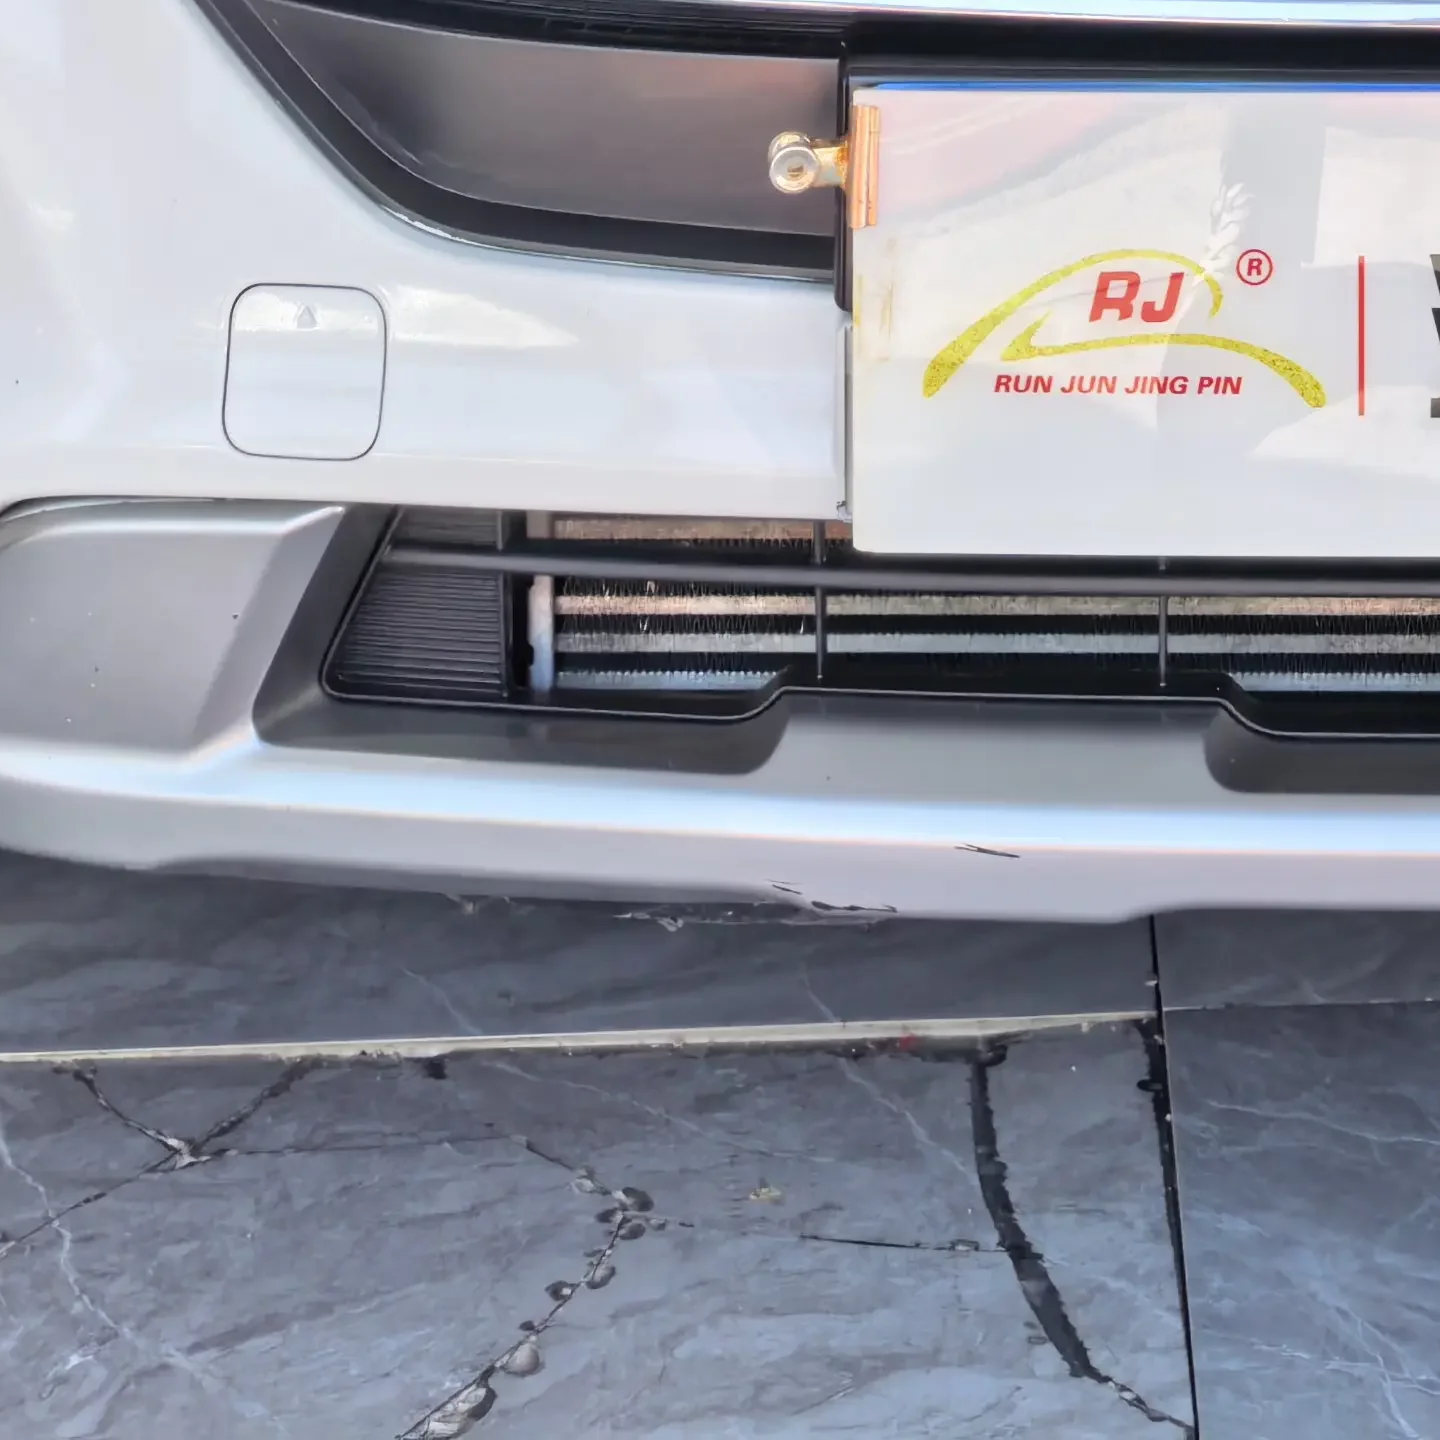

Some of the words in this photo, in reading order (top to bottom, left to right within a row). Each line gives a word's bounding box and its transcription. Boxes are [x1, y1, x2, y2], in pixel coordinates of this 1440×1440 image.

[1090, 270, 1184, 323] RJ
[994, 375, 1053, 394] RUN
[1061, 376, 1116, 394] JUN
[1124, 376, 1190, 396] JING
[1197, 376, 1242, 396] PIN
